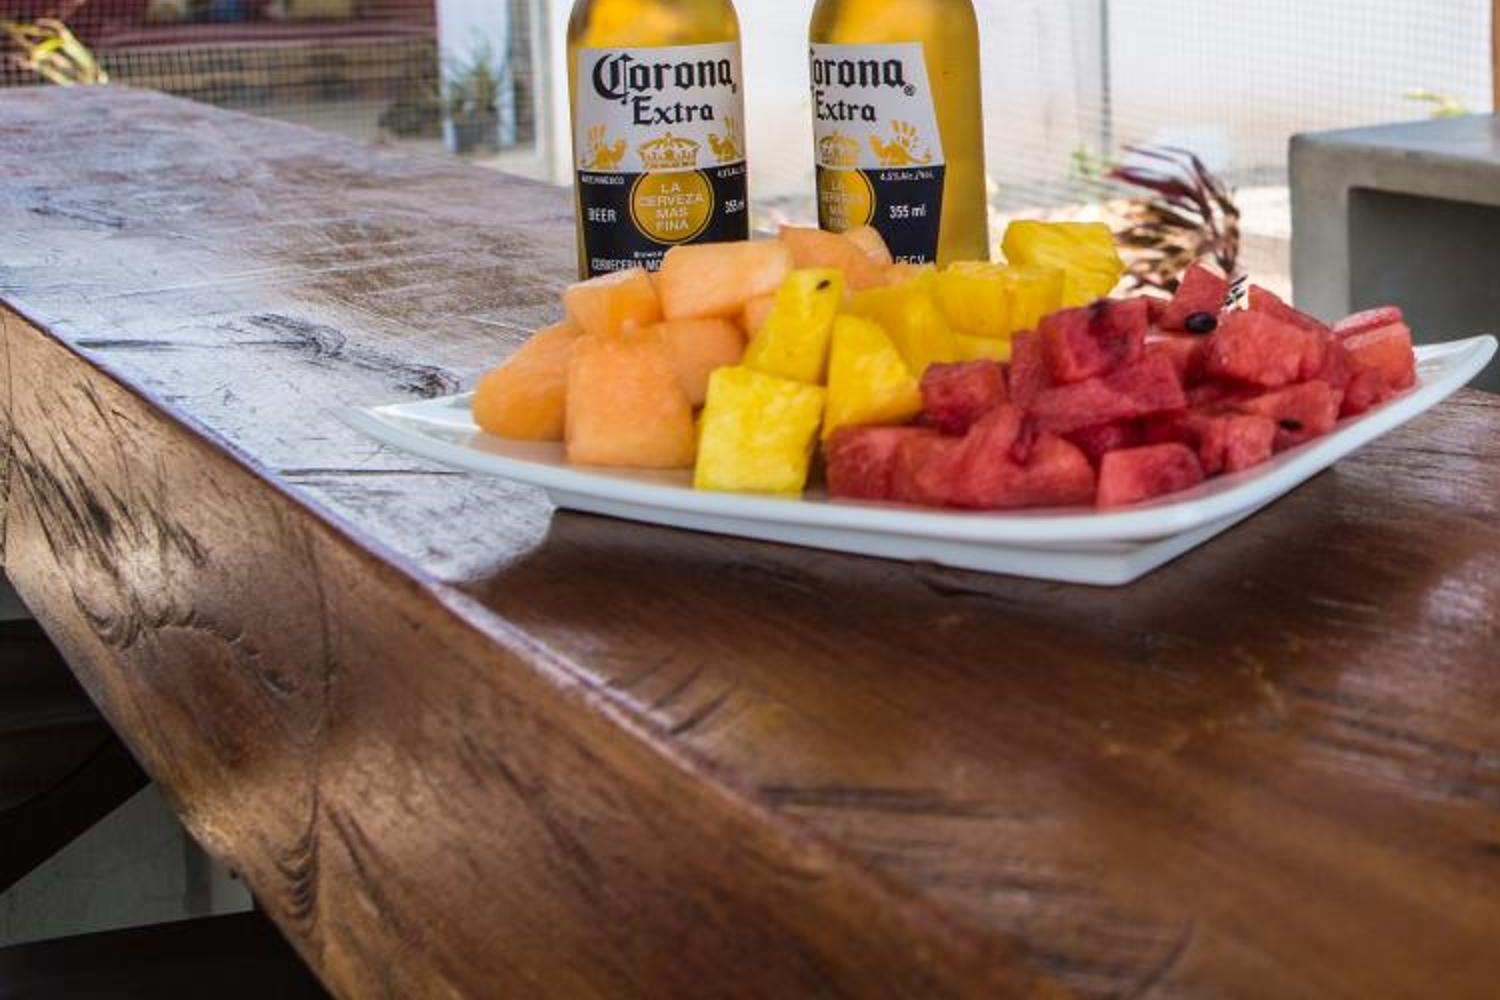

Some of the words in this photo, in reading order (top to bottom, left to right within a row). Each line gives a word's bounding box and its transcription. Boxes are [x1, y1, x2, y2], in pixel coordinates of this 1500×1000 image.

[592, 53, 733, 106] Corona
[631, 95, 714, 125] Extra
[815, 89, 876, 122] Extra
[661, 183, 681, 194] LA
[588, 207, 617, 223] BEER
[889, 205, 909, 219] 355
[911, 204, 926, 217] ml
